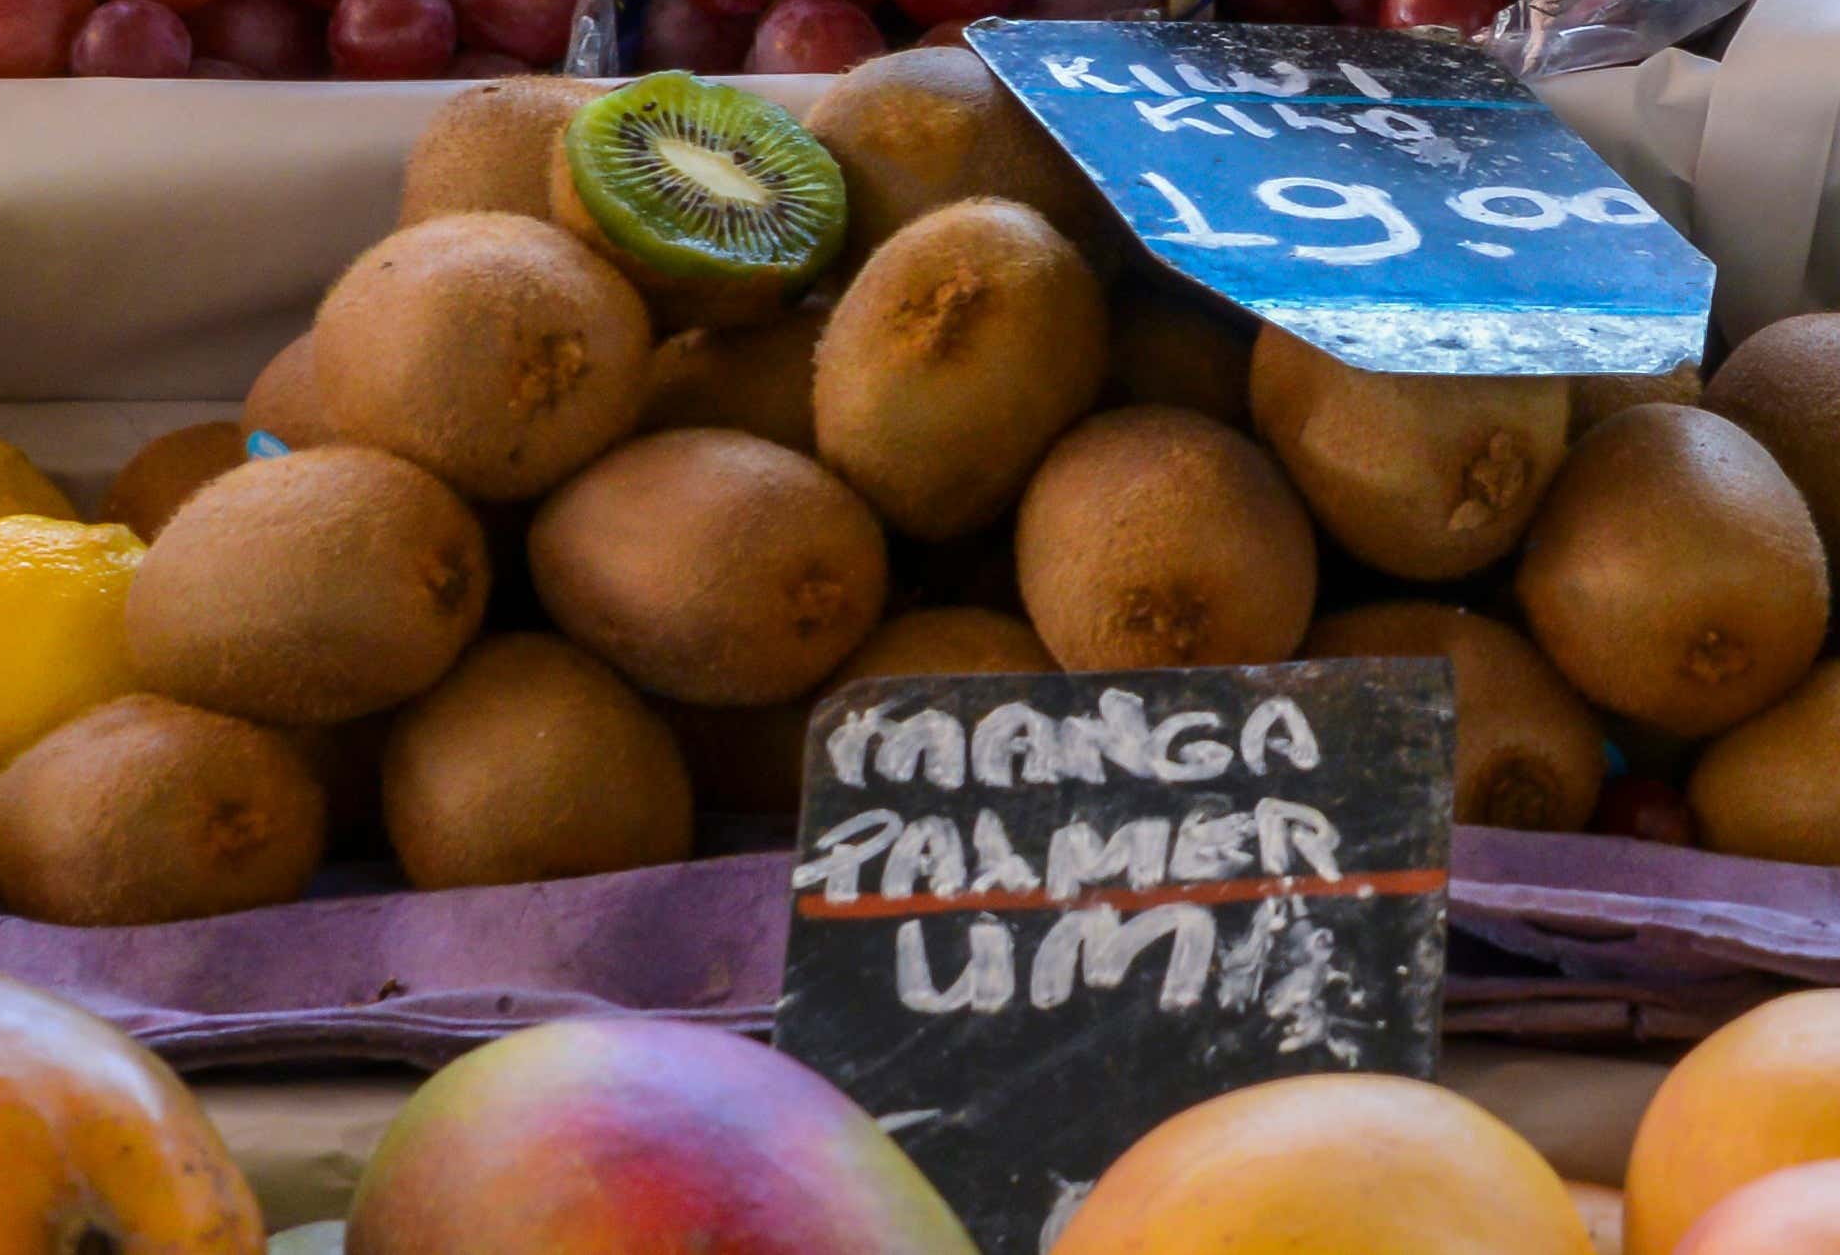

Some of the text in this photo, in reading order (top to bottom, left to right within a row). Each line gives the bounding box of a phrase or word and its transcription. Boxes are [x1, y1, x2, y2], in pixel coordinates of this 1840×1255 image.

[1038, 55, 1393, 102] KIWI
[1133, 96, 1440, 144] KILO
[1140, 171, 1665, 265] 19.00
[826, 687, 1320, 790] MANGA
[790, 796, 1344, 903] PALMER
